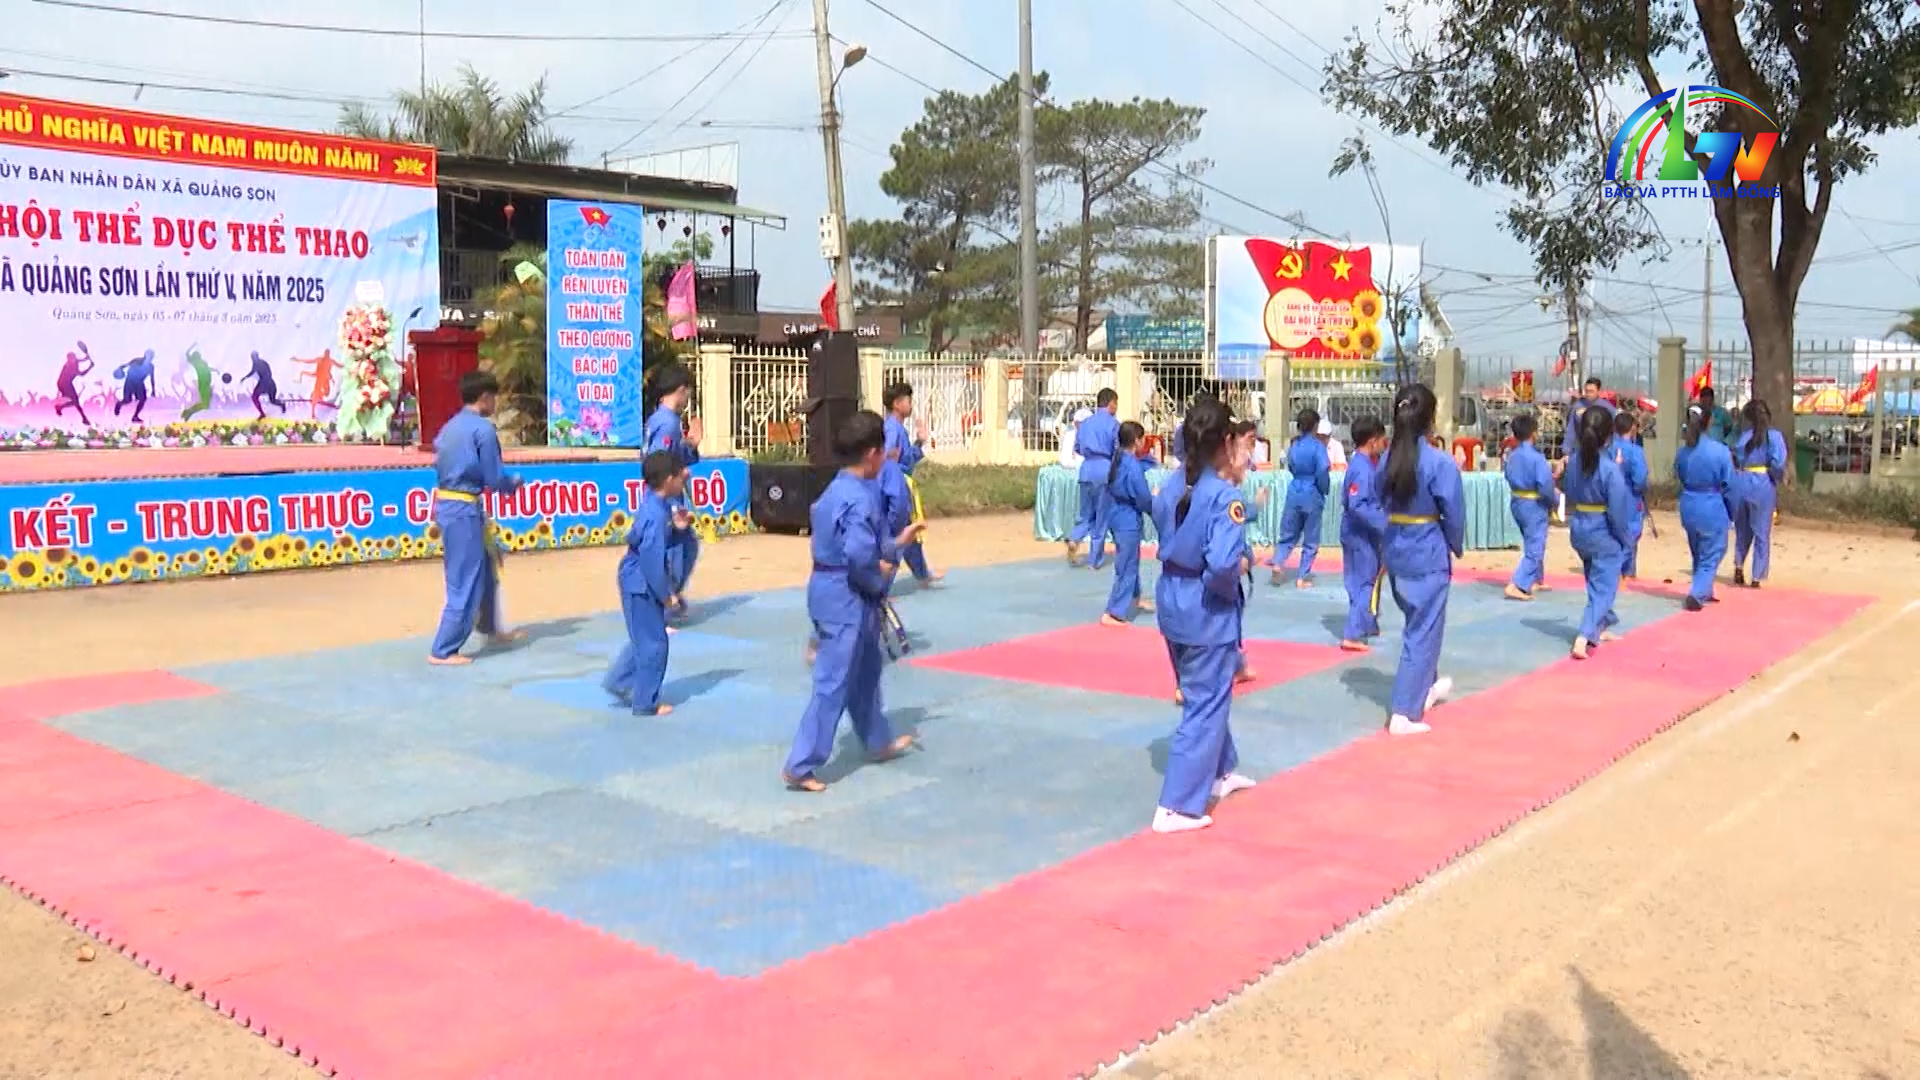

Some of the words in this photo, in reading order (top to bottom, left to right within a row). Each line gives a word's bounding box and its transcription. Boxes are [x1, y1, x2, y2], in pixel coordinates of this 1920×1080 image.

[42, 114, 126, 146] NGHĨA
[133, 125, 185, 154] VIỆT
[192, 133, 246, 158] NAM
[254, 139, 319, 166] MUÔN
[325, 145, 380, 172] NĂM!
[0, 157, 21, 178] ỦY
[29, 166, 64, 183] BAN
[70, 169, 118, 188] NHÂN
[123, 173, 156, 191] DÂN
[162, 177, 183, 194] XÃ
[188, 179, 242, 199] QUẢNG
[73, 201, 142, 246] THỂ
[152, 217, 217, 256] DỤC
[227, 213, 286, 254] THỂ
[295, 226, 369, 260] THAO
[22, 255, 91, 295] QUẢNG
[99, 265, 139, 296] SƠN
[145, 260, 181, 298] LẦN
[186, 267, 221, 299] THỨ
[242, 270, 281, 301] NĂM
[287, 276, 326, 303] 2025
[567, 248, 597, 267] TOÀN
[601, 248, 625, 268] DÂN
[568, 302, 599, 320] THÂN
[559, 331, 589, 347] THEO
[693, 471, 726, 512] BỘ
[13, 495, 95, 549] KẾT
[138, 497, 270, 542] TRUNG
[279, 489, 373, 536] THỰC
